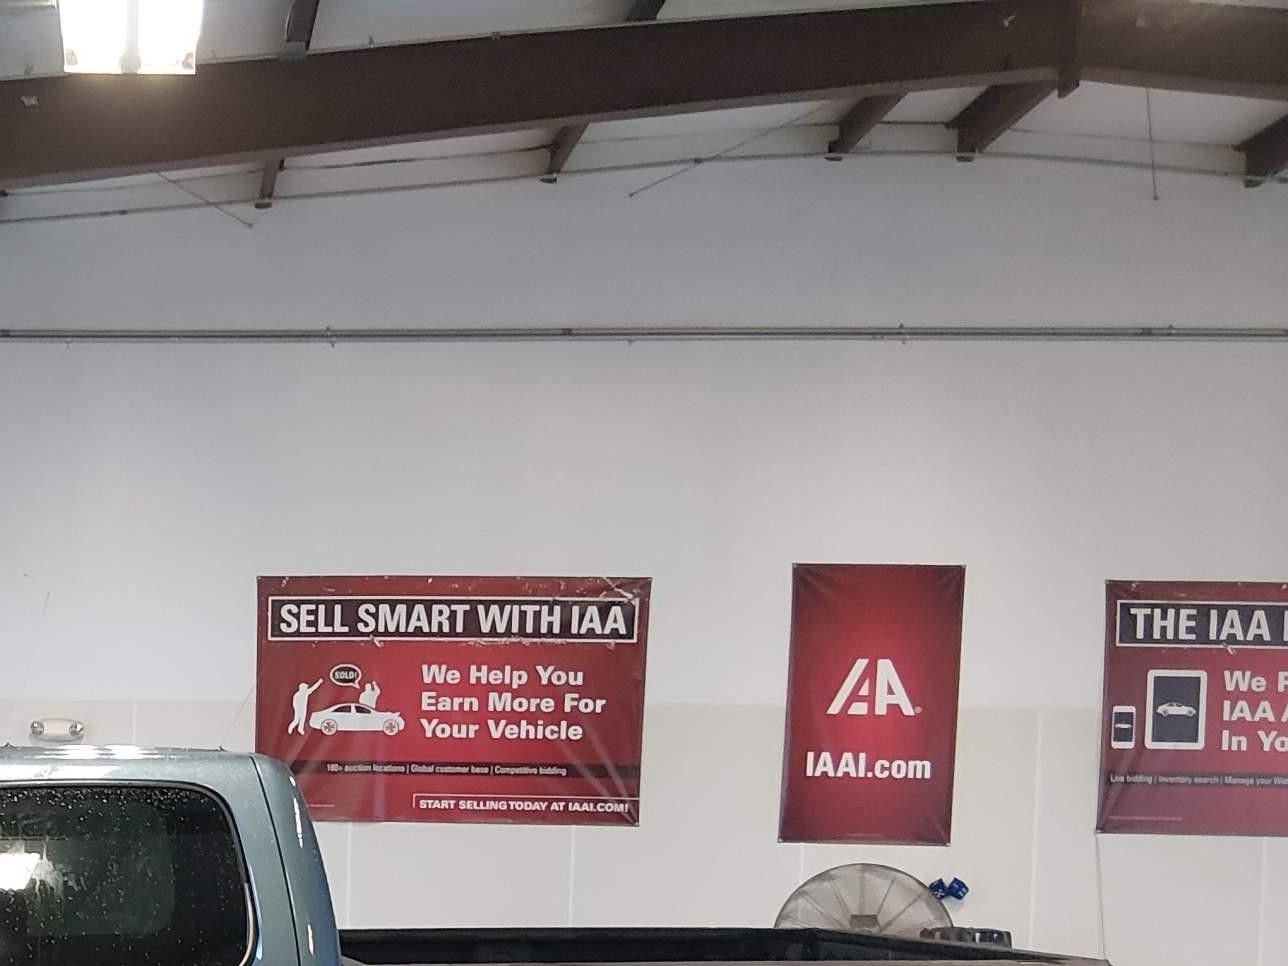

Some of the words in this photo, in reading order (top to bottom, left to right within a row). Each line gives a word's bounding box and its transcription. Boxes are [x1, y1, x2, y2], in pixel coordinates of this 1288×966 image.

[280, 604, 349, 633] SELL
[357, 604, 470, 633] SMART
[477, 604, 561, 634] WITH
[571, 605, 627, 635] IAA
[1130, 608, 1197, 640] THE
[1209, 609, 1271, 641] IAA
[334, 671, 358, 680] SOLD!
[422, 664, 460, 684] We
[469, 664, 528, 689] Help
[536, 666, 584, 686] You
[1224, 670, 1267, 692] We
[421, 692, 479, 711] Earn
[488, 692, 555, 712] More
[564, 694, 606, 713] For
[1223, 700, 1276, 722] IAA
[420, 719, 479, 739] Your
[488, 719, 583, 740] Vehicle
[1222, 730, 1247, 751] In
[411, 764, 434, 773] Global
[806, 751, 931, 779] IAAI.com
[419, 800, 456, 809] START
[459, 800, 507, 810] SELLING
[508, 801, 548, 811] TODAY
[550, 802, 566, 811] AT
[568, 802, 628, 812] IAAI.COM!
